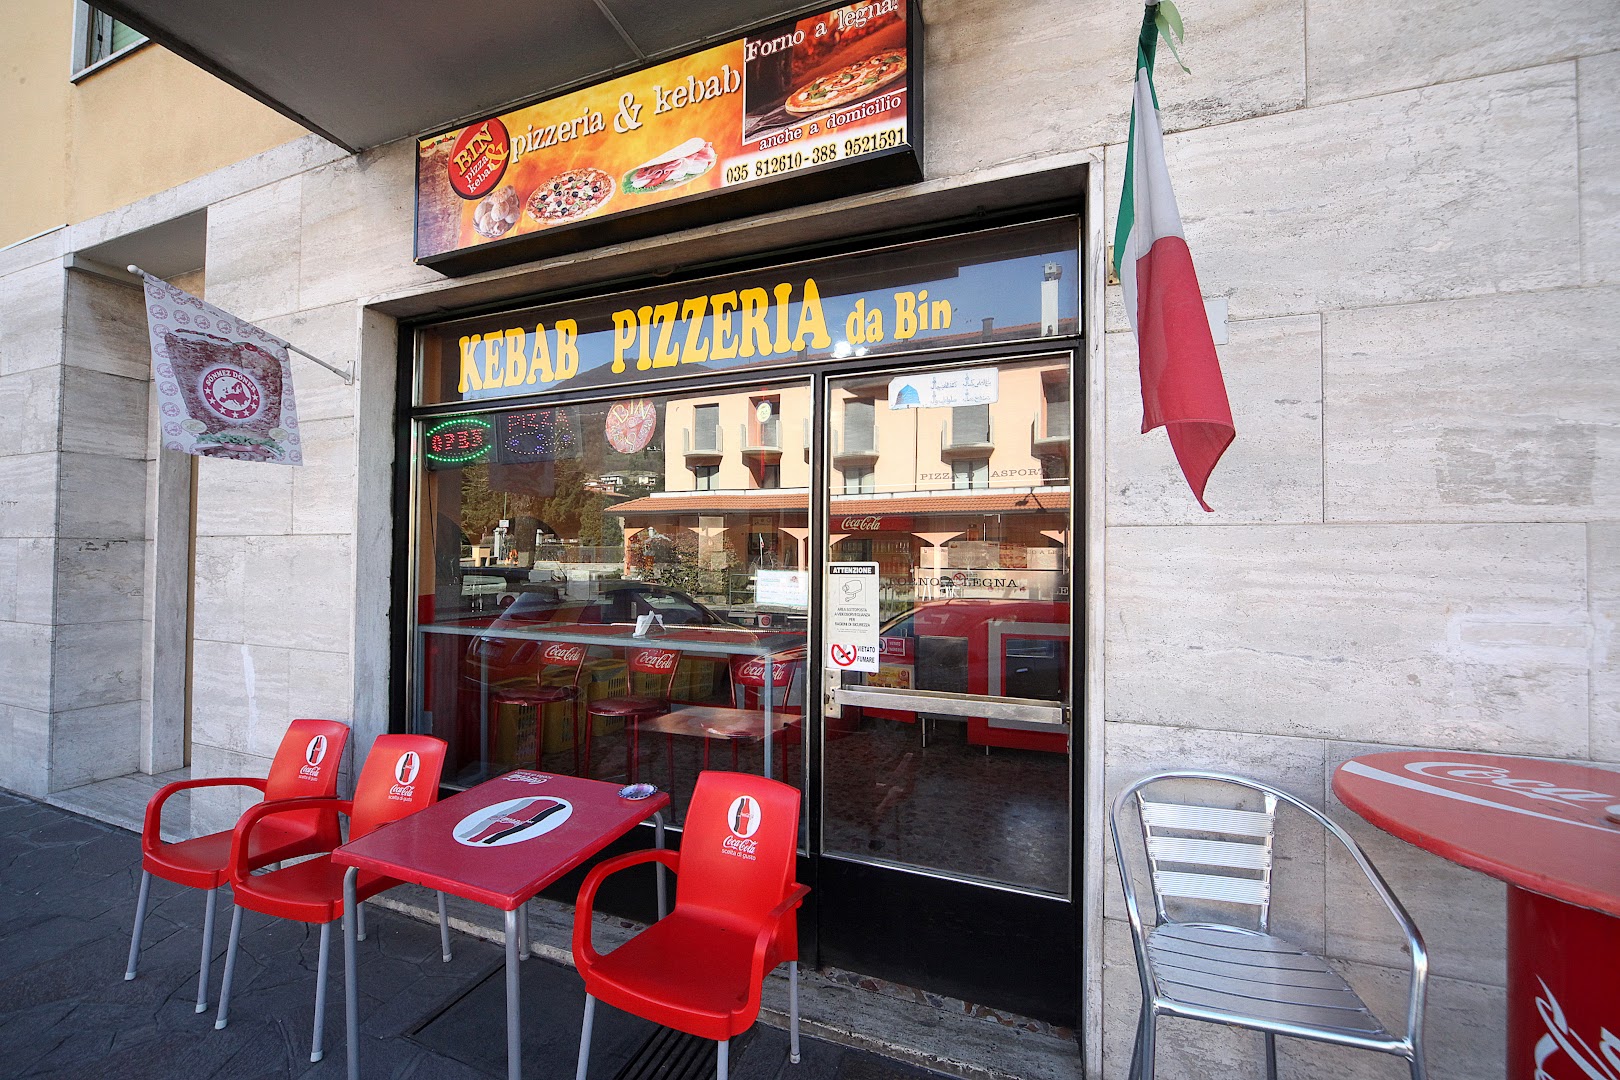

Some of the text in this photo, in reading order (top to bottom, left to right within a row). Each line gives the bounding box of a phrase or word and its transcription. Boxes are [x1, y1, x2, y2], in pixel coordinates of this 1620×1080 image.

[745, 30, 805, 63] Forno
[815, 22, 828, 39] a
[510, 64, 742, 164] pizzeria & kebab
[759, 94, 902, 151] anche a domicilio
[453, 122, 493, 176] BIN
[726, 164, 749, 184] 035
[844, 127, 906, 157] 9521591
[465, 156, 489, 184] pizza
[457, 277, 952, 394] KEBAB PIZZERIA da Bin
[508, 410, 569, 433] PIZZA
[920, 472, 959, 481] PIZZA
[841, 515, 882, 531] Coca-Cola
[833, 566, 872, 574] ATTENZIONE
[962, 578, 1018, 588] LEGNA
[544, 643, 582, 661] Coca-Cola
[857, 645, 876, 653] VIETATO
[635, 650, 676, 670] Coca-Cola
[857, 656, 875, 664] FUMARE
[390, 784, 415, 797] Coca-Cola
[722, 848, 737, 857] scelta
[743, 853, 757, 861] gusto
[723, 835, 758, 855] Coca-Cola
